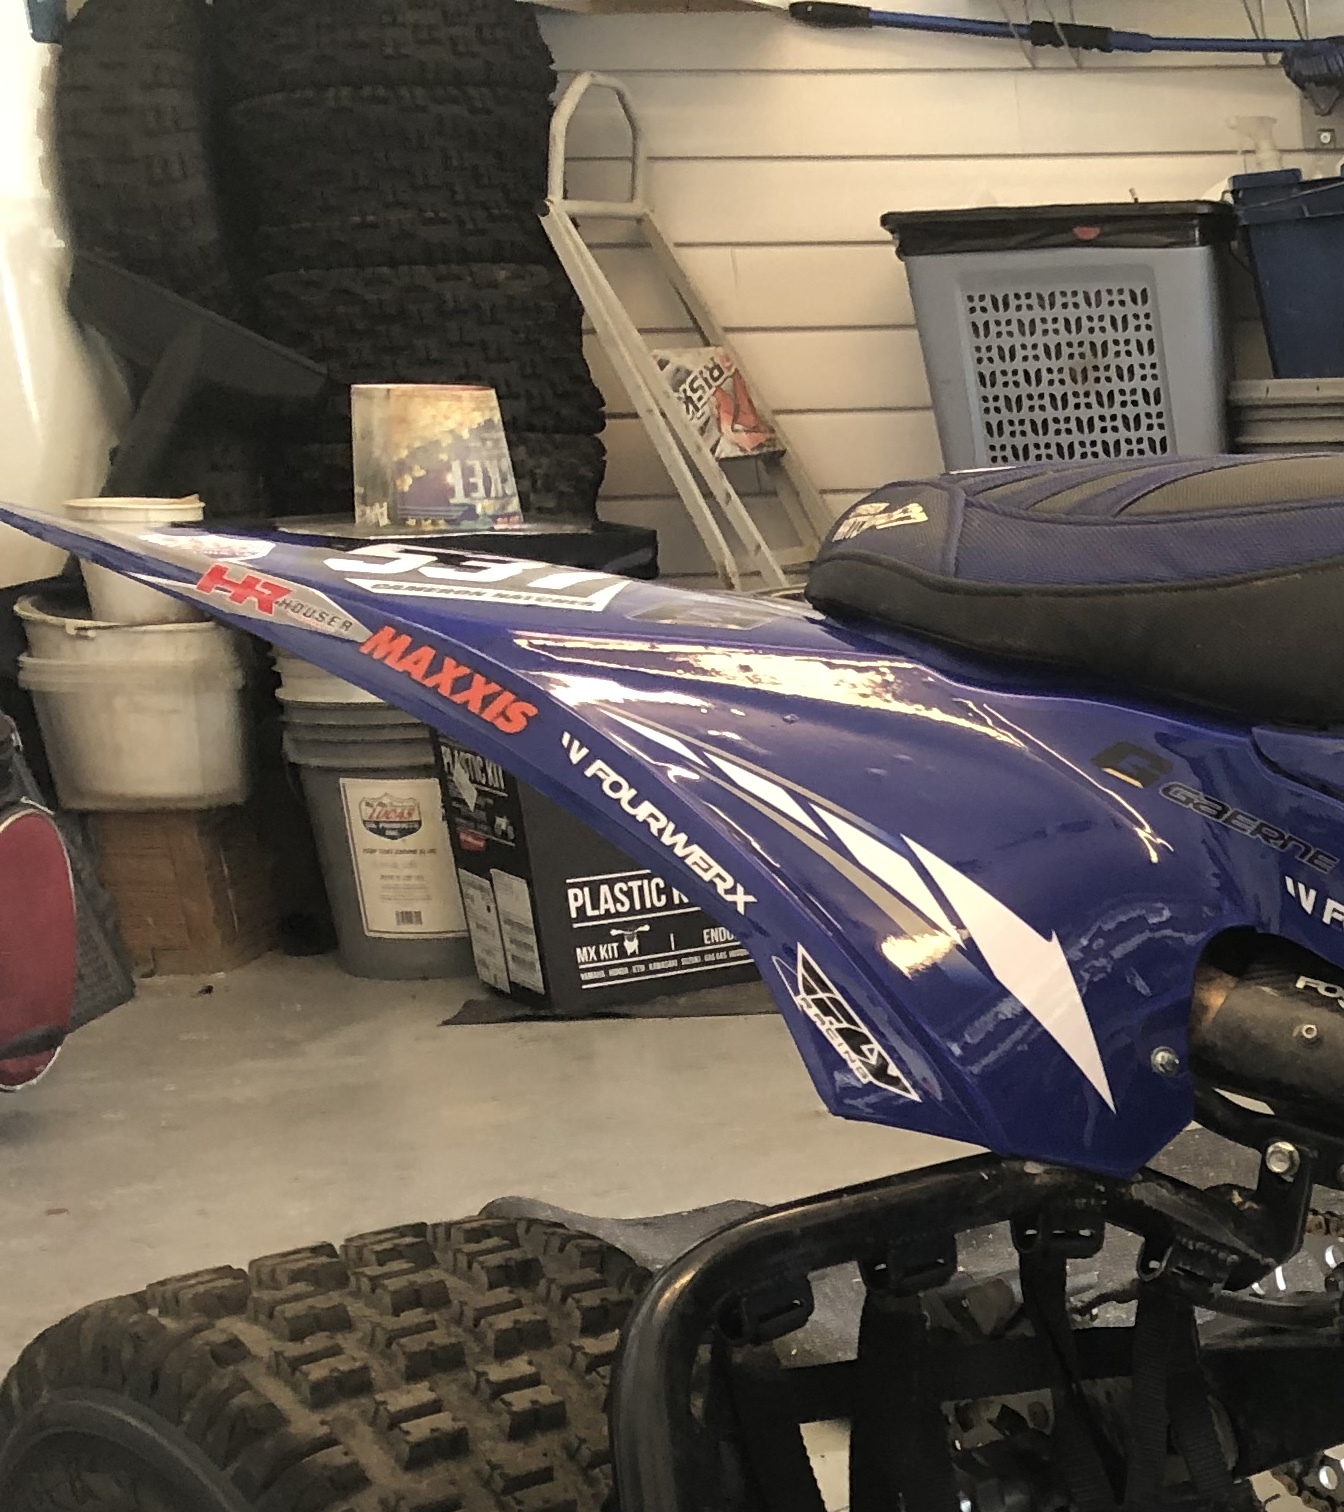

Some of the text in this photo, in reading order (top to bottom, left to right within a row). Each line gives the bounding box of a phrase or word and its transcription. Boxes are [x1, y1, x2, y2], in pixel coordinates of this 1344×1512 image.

[278, 599, 353, 632] HOUSER
[362, 626, 538, 734] MAXXIS
[584, 759, 757, 915] FOURWERX
[567, 877, 668, 919] PLASTIC
[576, 945, 598, 964] MX
[599, 942, 620, 961] KIT
